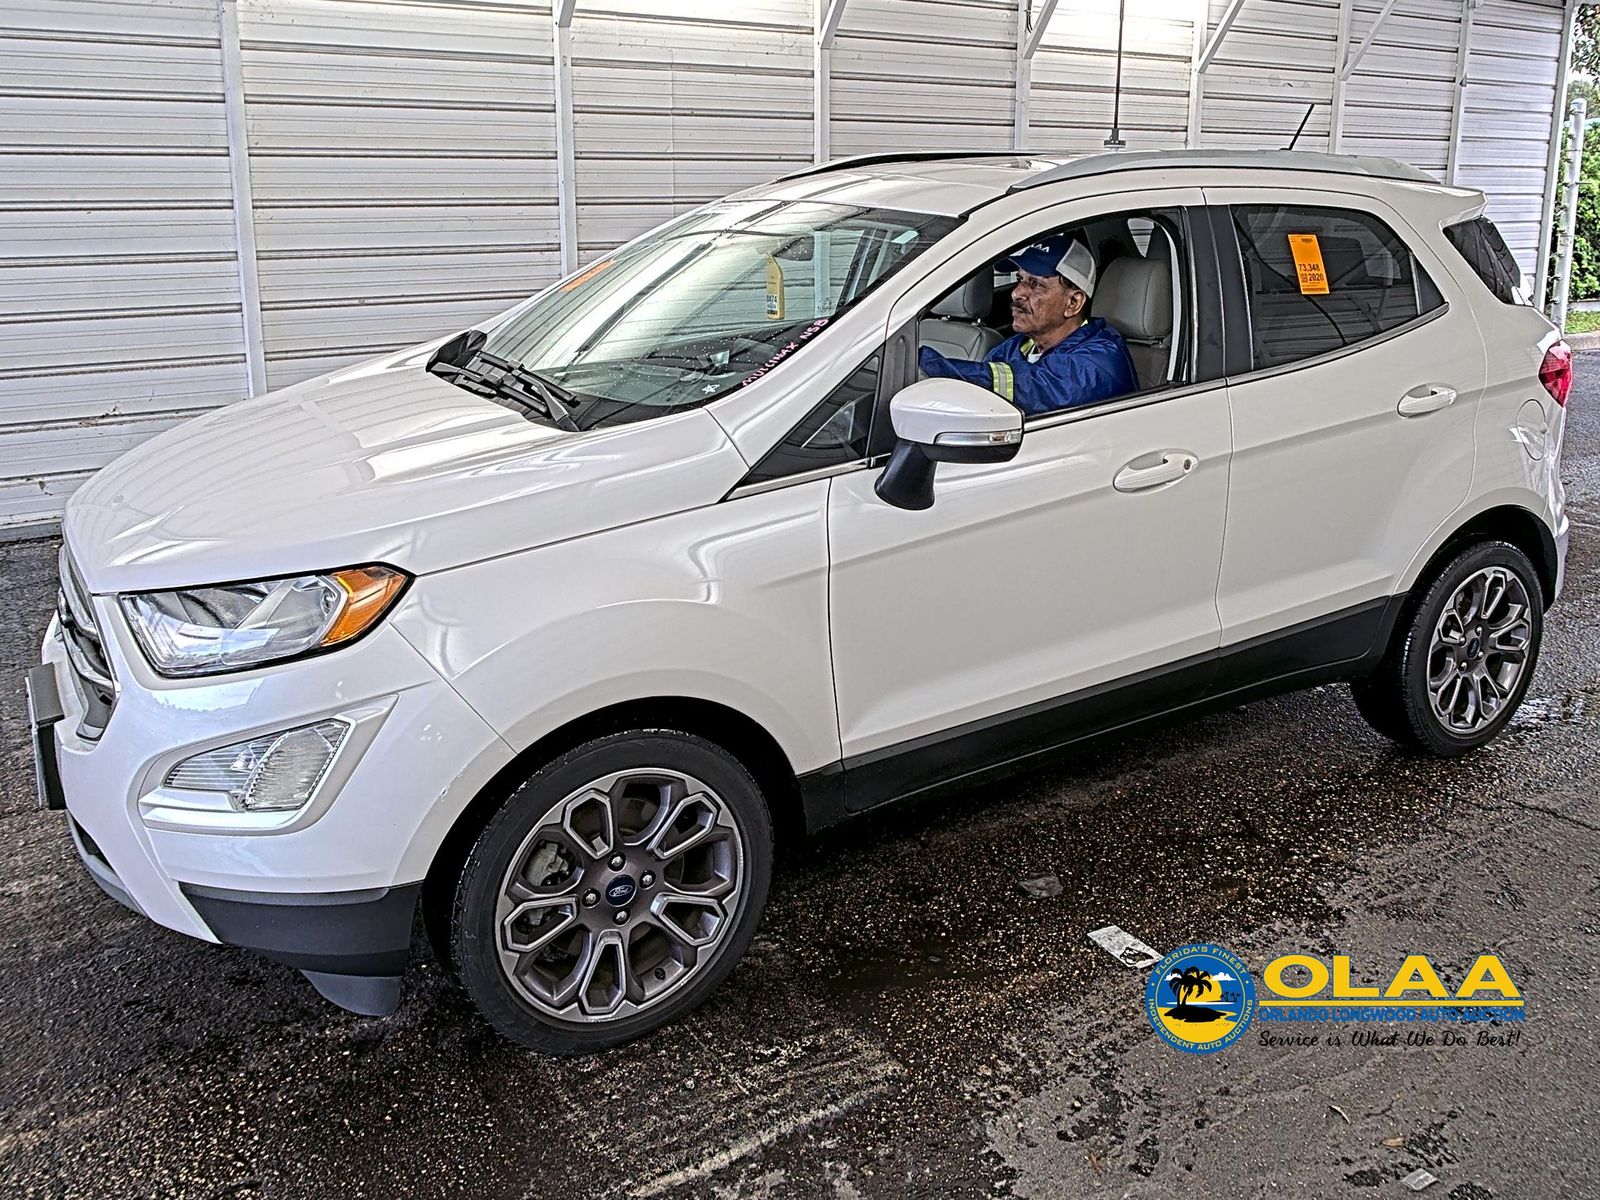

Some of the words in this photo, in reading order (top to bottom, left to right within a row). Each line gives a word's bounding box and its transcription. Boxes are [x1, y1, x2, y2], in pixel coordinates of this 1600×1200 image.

[1298, 263, 1321, 272] 73,348
[1309, 273, 1325, 282] 2020
[799, 319, 829, 340] NSB
